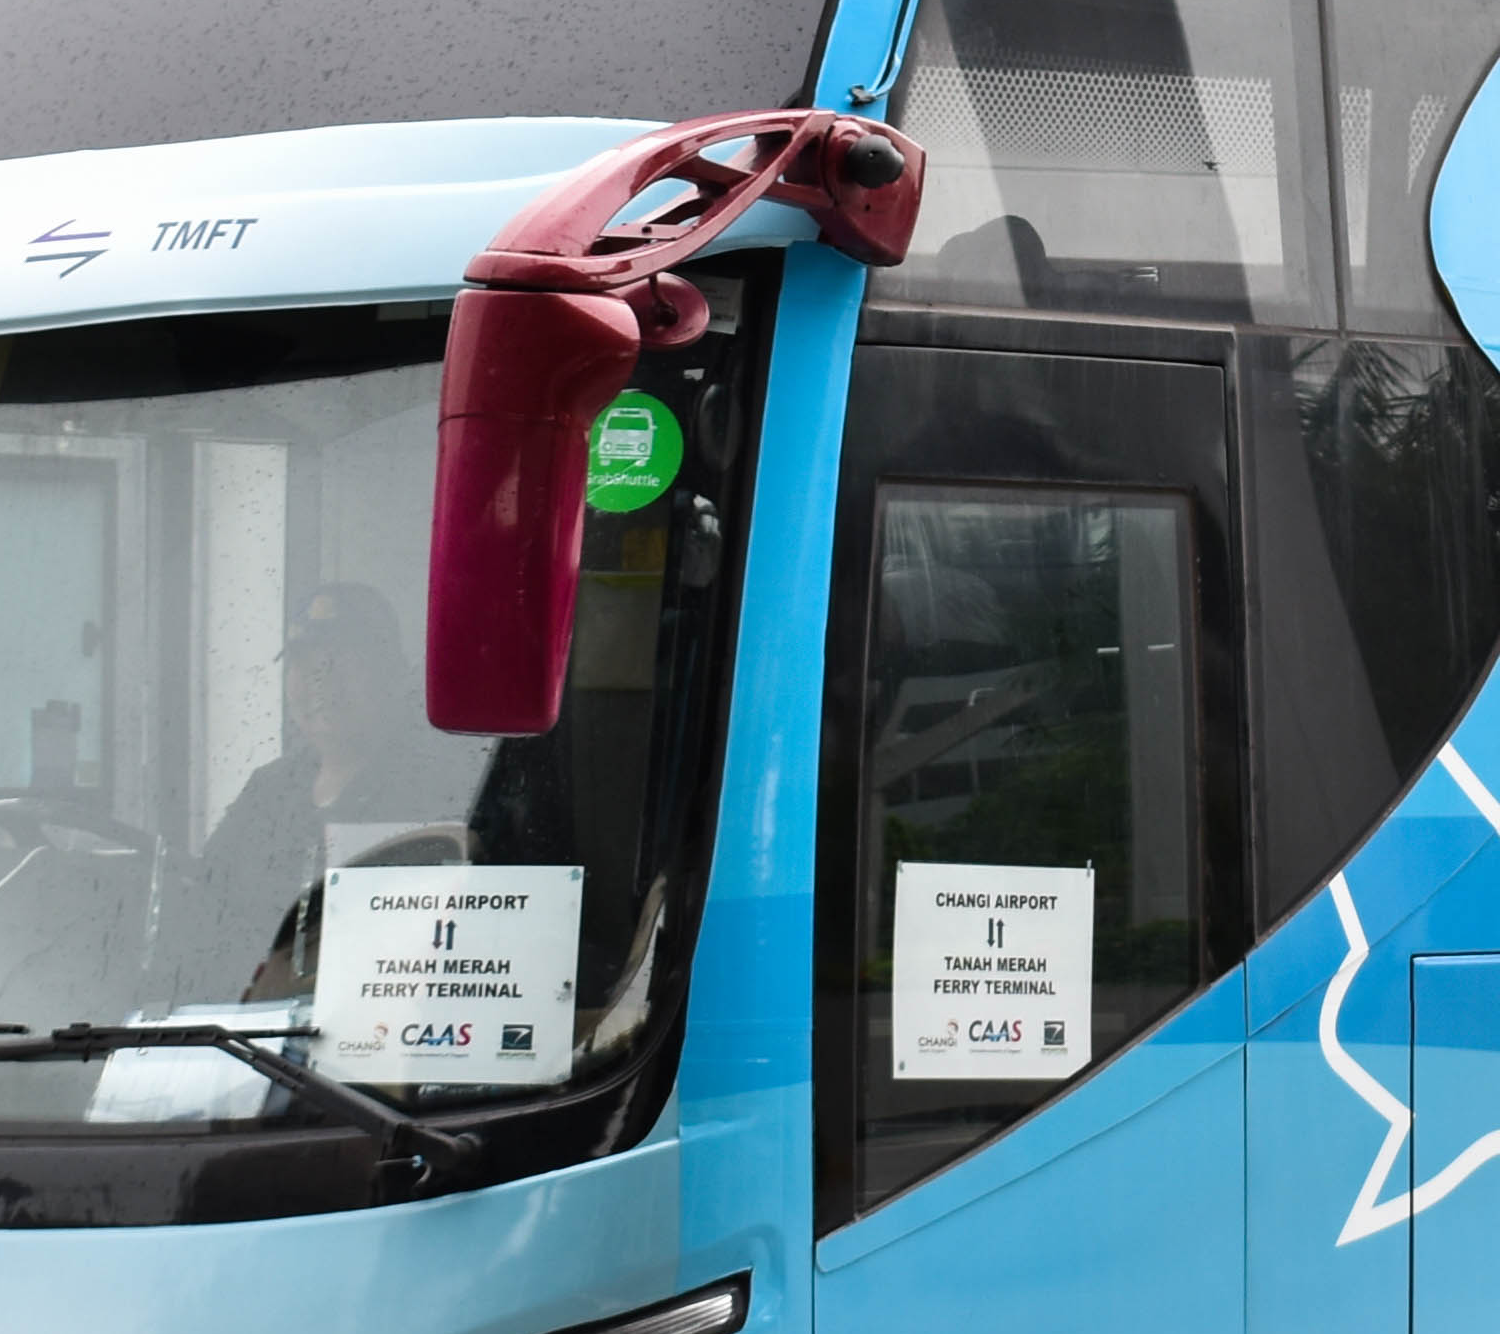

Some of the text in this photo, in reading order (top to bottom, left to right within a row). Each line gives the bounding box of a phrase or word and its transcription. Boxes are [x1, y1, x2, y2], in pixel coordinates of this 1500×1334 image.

[150, 217, 259, 253] TMFT
[369, 894, 530, 911] CHANGI AIRPORT
[935, 892, 1058, 910] CHANGI AIRPORT
[375, 959, 511, 975] TANAH MERAH
[943, 955, 1047, 972] TANAH MERAH
[360, 982, 523, 998] FERRY TERMINAL
[933, 979, 1056, 996] FERRY TERMINAL
[401, 1022, 473, 1047] CAAS
[968, 1019, 1023, 1043] CAAS
